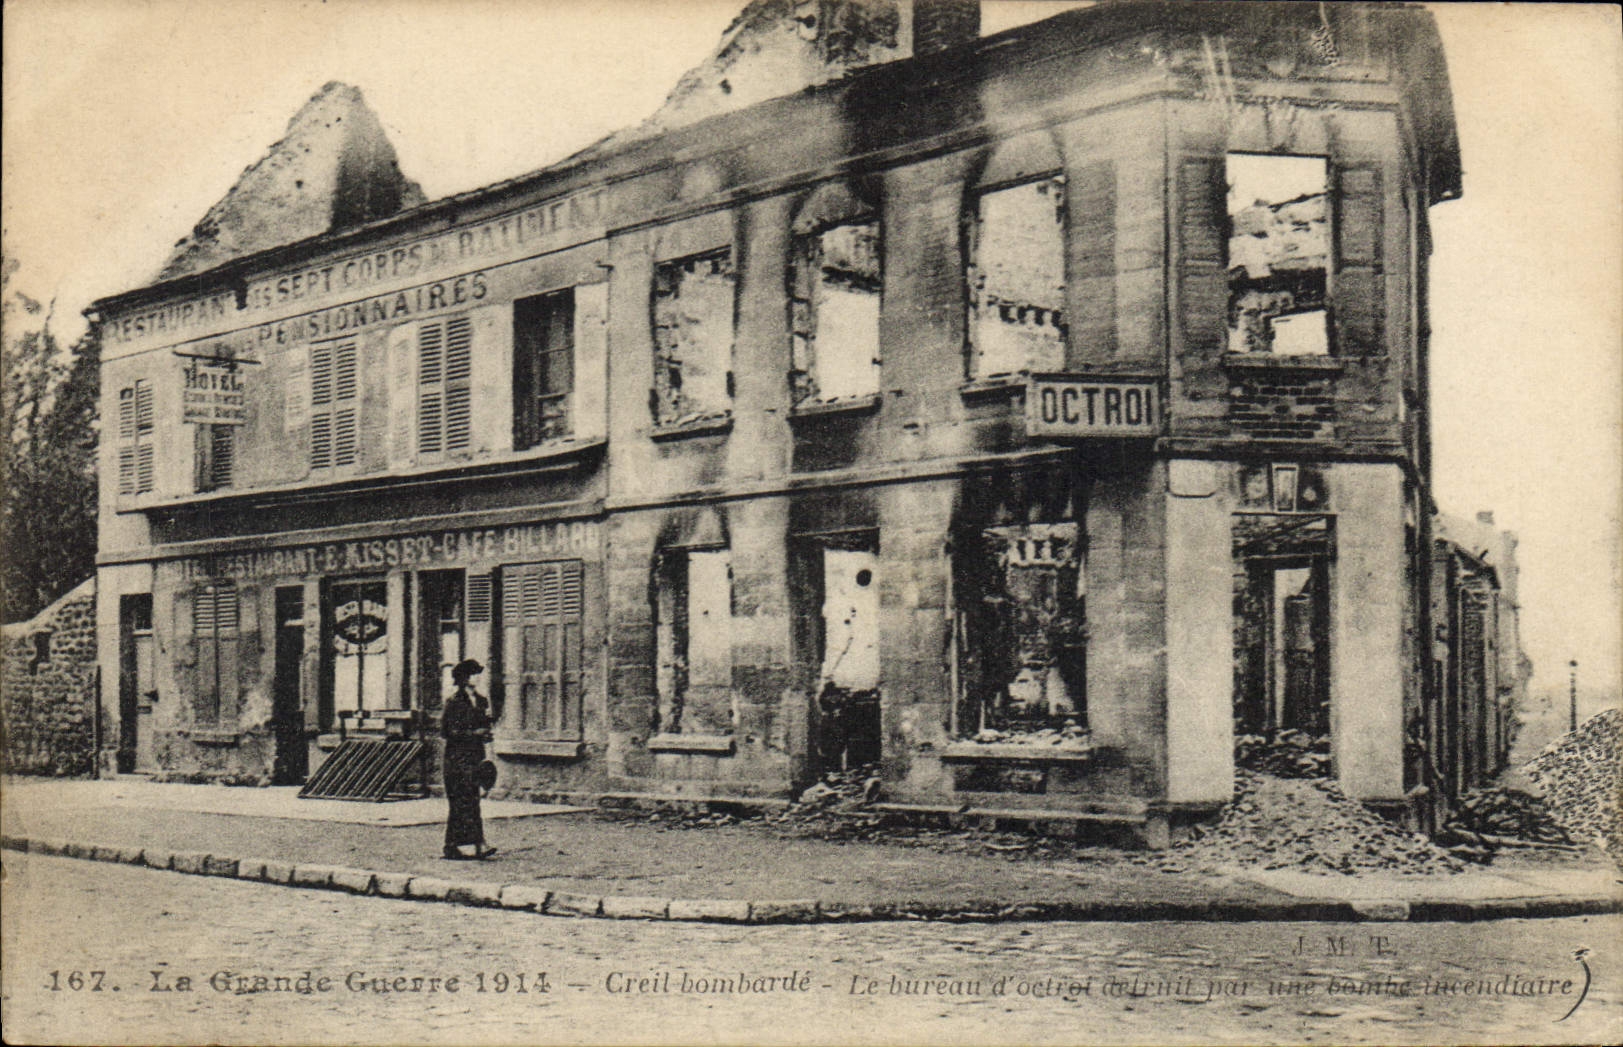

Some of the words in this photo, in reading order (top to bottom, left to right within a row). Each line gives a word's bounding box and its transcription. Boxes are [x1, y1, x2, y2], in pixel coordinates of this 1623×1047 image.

[277, 265, 334, 303] SEPT
[344, 244, 423, 288] CORPS
[258, 272, 489, 346] PENSIONNAIRES
[183, 366, 244, 392] HOTEL
[1041, 387, 1153, 425] OCTROI
